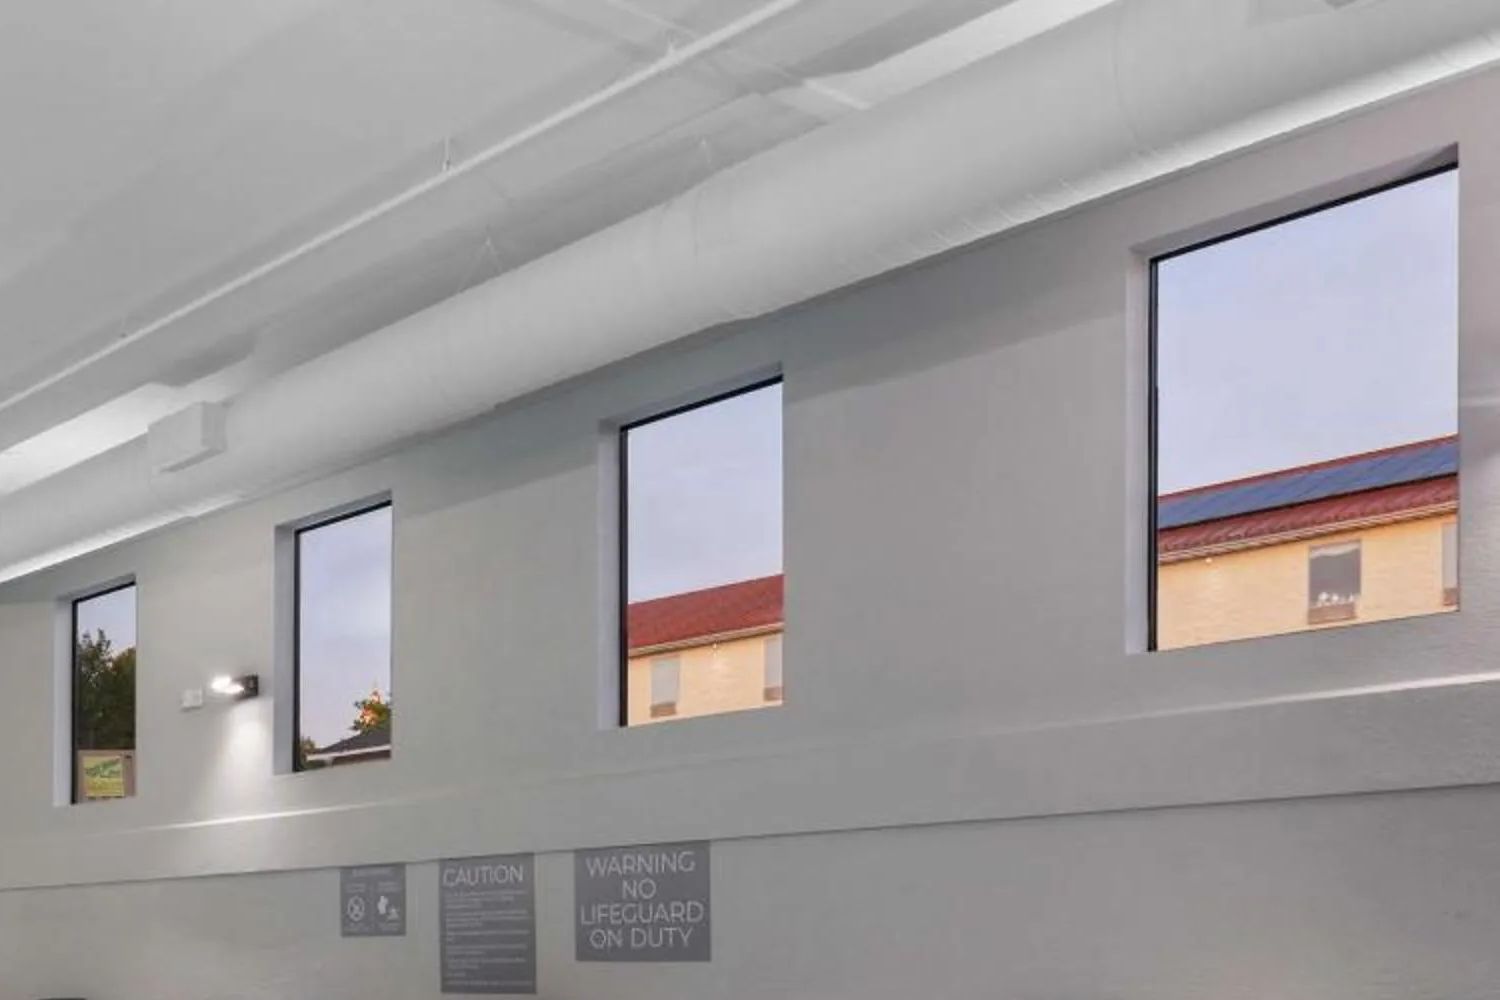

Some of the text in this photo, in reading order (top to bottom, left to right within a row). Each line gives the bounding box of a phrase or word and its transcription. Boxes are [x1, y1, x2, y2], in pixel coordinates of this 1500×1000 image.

[585, 850, 696, 877] WARNING
[443, 864, 524, 887] CAUTION
[622, 878, 656, 899] NO
[580, 900, 704, 925] LIFEGUARD
[589, 926, 693, 949] ON DUTY
